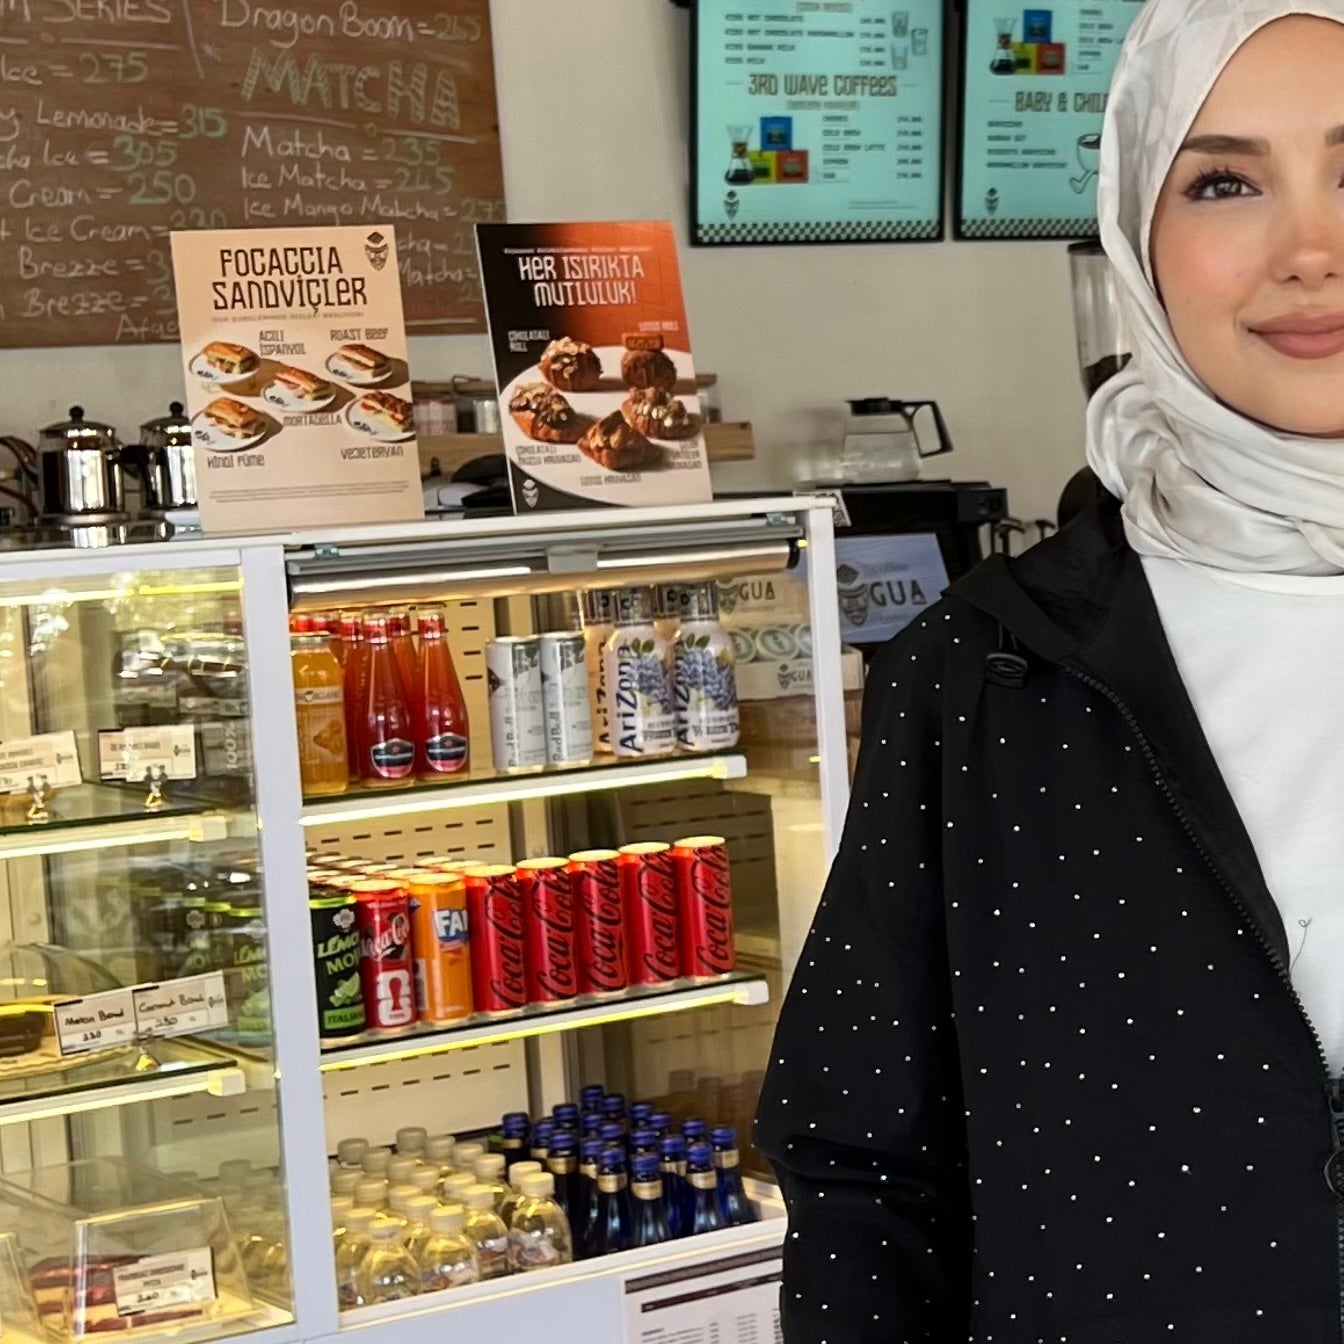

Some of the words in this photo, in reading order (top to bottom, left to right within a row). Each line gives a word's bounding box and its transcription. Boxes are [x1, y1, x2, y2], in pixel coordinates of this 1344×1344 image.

[79, 52, 149, 84] 275
[240, 47, 460, 130] MATCHA
[748, 74, 778, 95] 3RD
[784, 74, 828, 96] WAVE
[833, 74, 897, 97] COFFEES
[1015, 91, 1052, 112] BABY
[36, 99, 162, 136] Lemonade
[177, 102, 229, 139] 315
[103, 133, 178, 171] 305
[241, 125, 352, 161] Matcha
[380, 137, 442, 166] 235
[9, 178, 92, 208] Cream
[128, 170, 196, 205] 250
[241, 166, 272, 189] Ice
[277, 162, 367, 192] Matcha
[244, 197, 276, 220] Ice
[283, 193, 354, 226] Mango
[360, 194, 440, 221] Matcha
[26, 217, 63, 243] Ice
[70, 214, 150, 242] Cream
[220, 246, 343, 277] FOCACCIA
[518, 256, 557, 281] HER
[562, 255, 645, 280] ISIRIKTA
[212, 274, 367, 315] SANDVİÇLER
[534, 281, 637, 307] MUTLULUK!
[739, 581, 775, 600] GUA
[870, 579, 928, 606] GUA
[616, 641, 644, 753] AriZona
